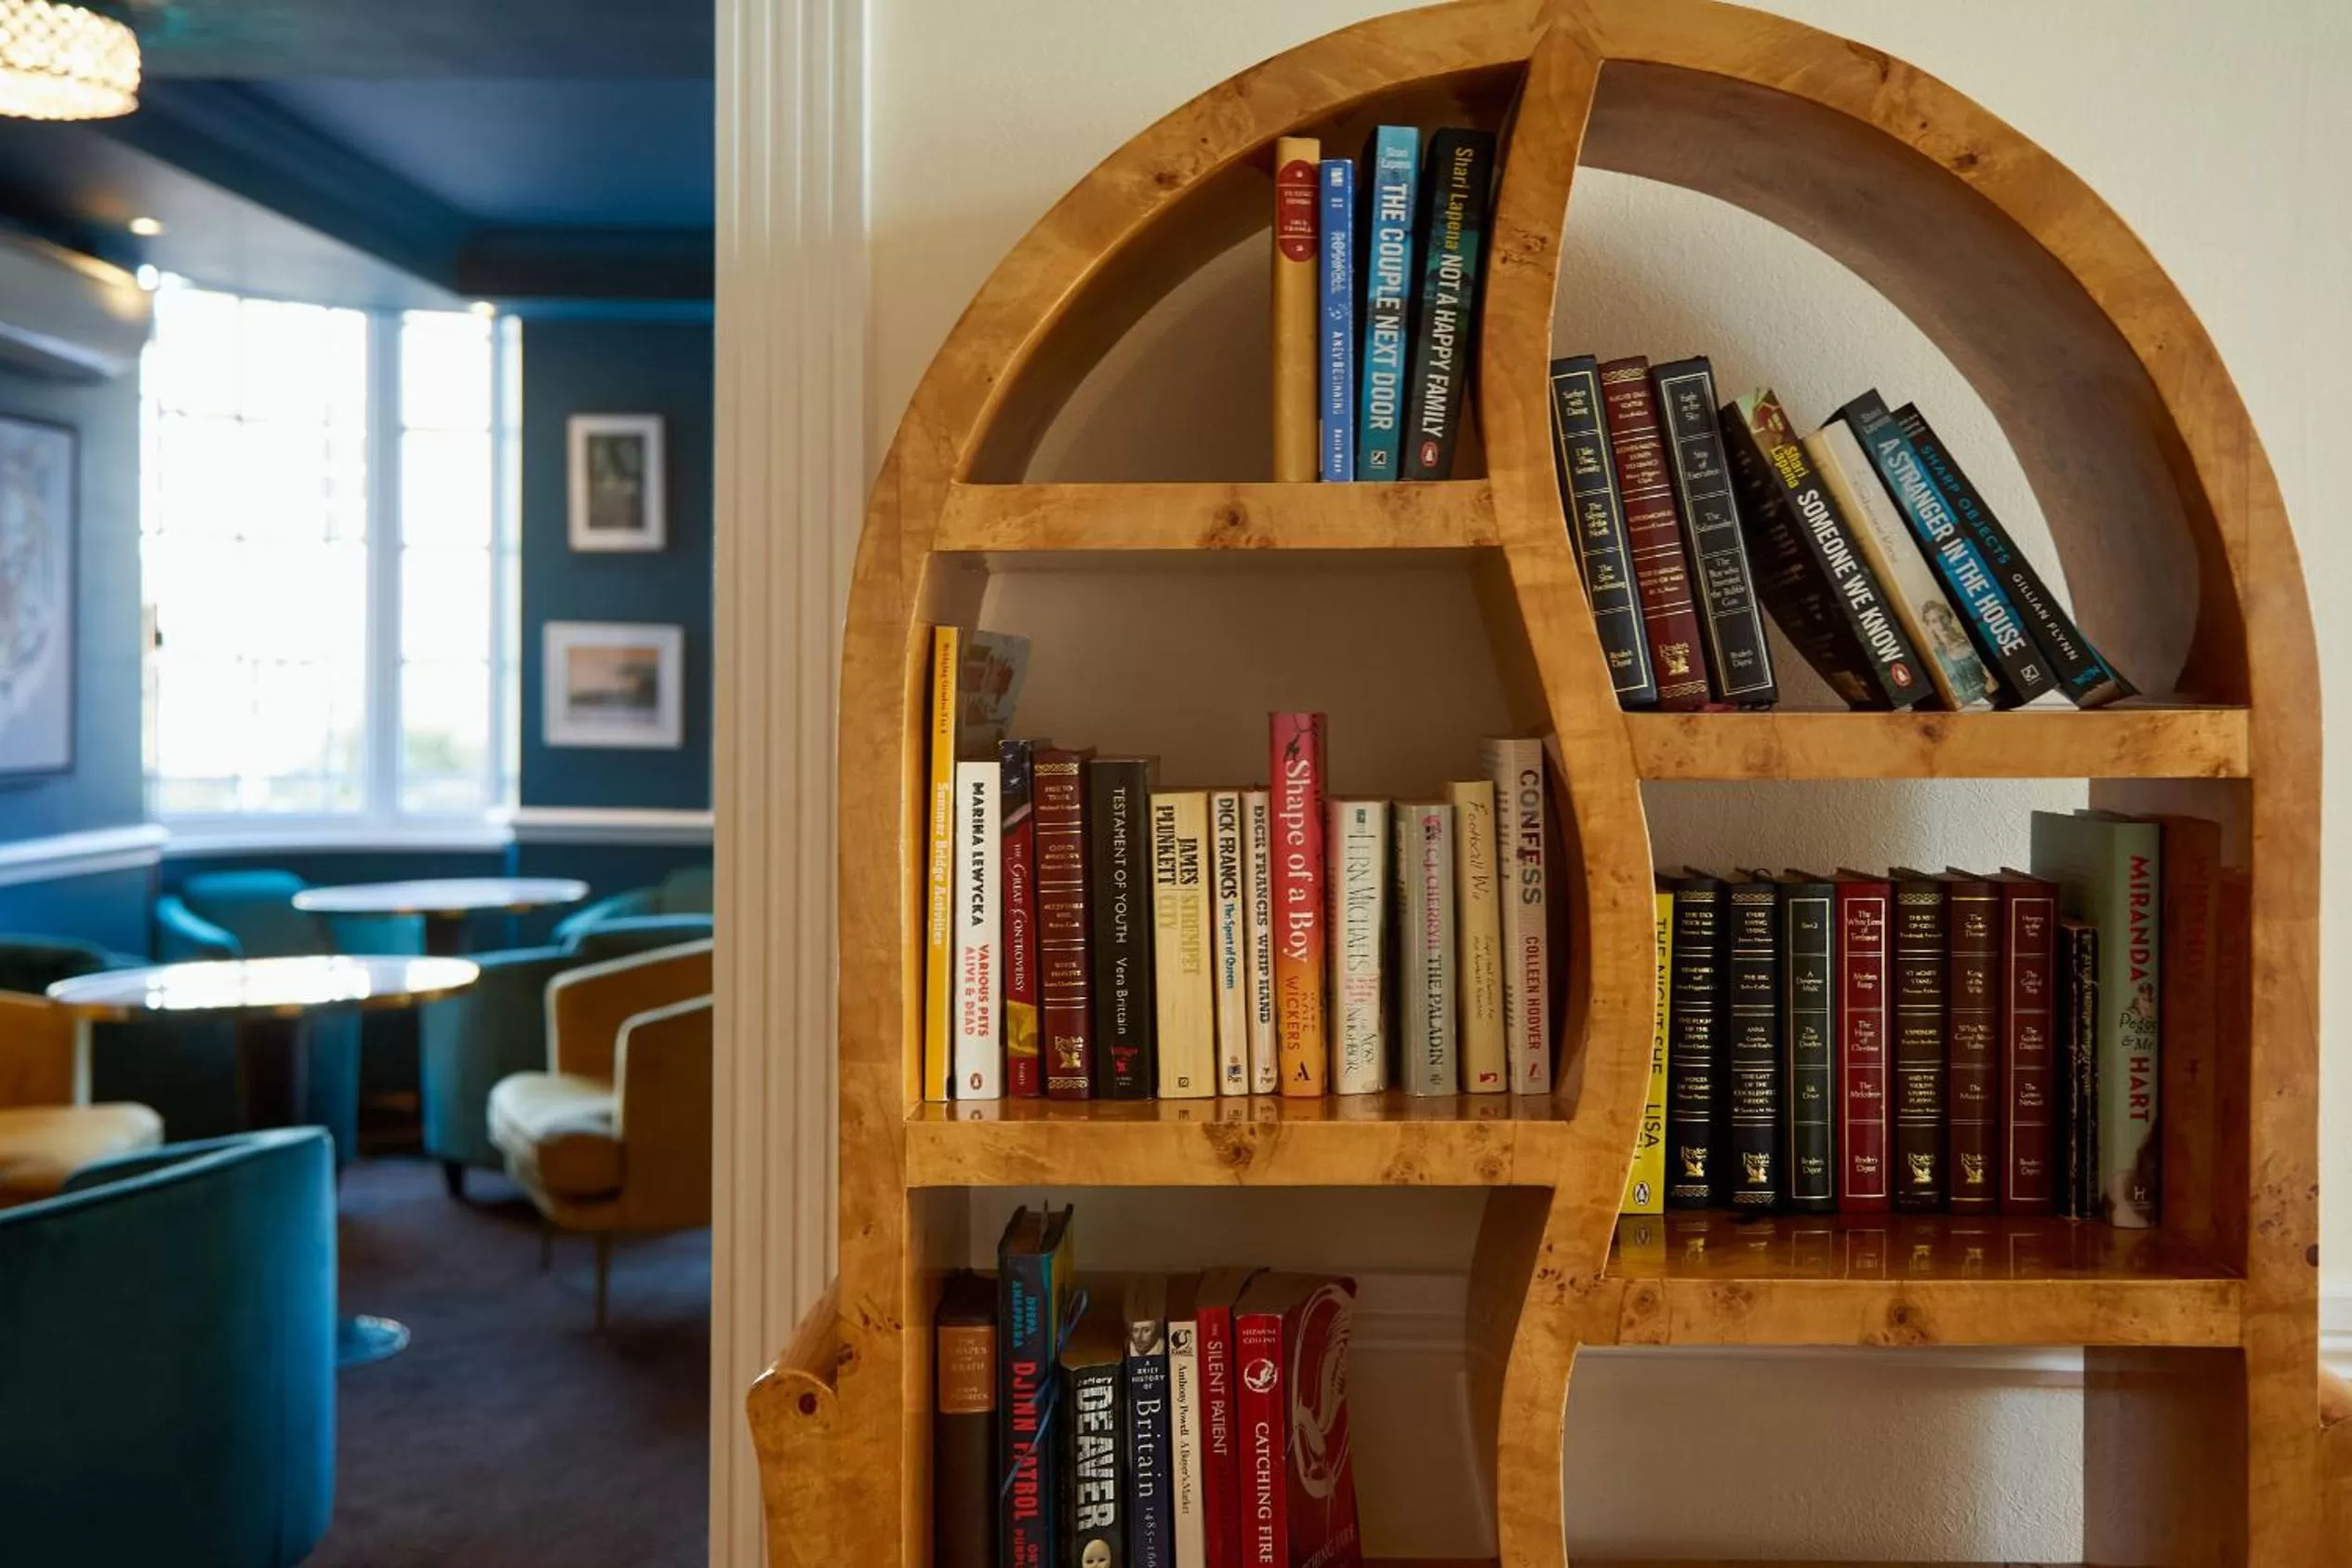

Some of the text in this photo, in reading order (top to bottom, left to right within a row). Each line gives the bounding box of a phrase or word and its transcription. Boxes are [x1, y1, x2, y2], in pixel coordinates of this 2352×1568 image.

[1380, 183, 1408, 221] THE
[1376, 228, 1405, 309] COUPLE
[1421, 147, 1473, 439] Shari Lapena NOT A HAPPY FAMILY
[1372, 315, 1400, 368] NEXT
[1368, 371, 1396, 430] DOOR
[1770, 445, 1800, 489] Lapena
[1785, 445, 1811, 478] Shari
[1878, 438, 1901, 455] A
[1887, 451, 1955, 543] STRANGER
[1921, 445, 2011, 565] SHARP OBJECTS
[1797, 489, 1857, 579] SOMEONE
[1940, 538, 1969, 564] IN
[1842, 574, 1874, 611] WE
[1954, 557, 1990, 598] THE
[1857, 606, 1904, 663] KNOW
[1974, 593, 2027, 658] HOUSE
[2013, 573, 2080, 662] GILLIAN FLYNN
[1156, 805, 1176, 885] PLUNKETT
[1218, 798, 1235, 831] DICK
[1468, 801, 1488, 869] Football
[1519, 769, 1541, 905] CONFESS
[933, 782, 950, 947] Summer Bridge Activities
[972, 782, 984, 927] MARINA LEWYCKA
[1176, 837, 1199, 885] JAMES
[1219, 837, 1238, 899] FRANCIS
[1279, 760, 1313, 963] Shape of a Boy
[1423, 848, 1438, 871] C.J.
[1112, 788, 1129, 1034] TESTAMENT OF YOUTH Vera Brittain
[1159, 895, 1178, 929] CITY
[1180, 895, 1200, 976] STRUMPET
[1225, 904, 1235, 919] The
[1254, 804, 1270, 1024] DICK FRANCIS WHIP HAND
[1348, 886, 1376, 971] MICHAELS
[1655, 918, 1667, 957] THE
[2130, 855, 2149, 982] MIRANDA
[1010, 907, 1027, 991] CONTROVERSY
[1225, 946, 1235, 956] of
[1428, 954, 1442, 990] THE
[964, 947, 976, 1035] ALIVE & DEAD
[977, 944, 990, 1037] VARIOUS PETS
[1285, 976, 1300, 1051] WICKERS
[1525, 937, 1541, 1050] COLLEEN HOOVER
[1428, 992, 1443, 1066] PALADIN
[2130, 1056, 2149, 1123] HART
[1644, 1103, 1661, 1149] LISA
[1012, 1280, 1024, 1349] ANAPPARA
[1025, 1295, 1038, 1335] DEEPA
[1132, 1375, 1166, 1384] HISTORY
[1177, 1364, 1188, 1403] Anthony
[1208, 1341, 1224, 1396] SILENT
[1012, 1360, 1039, 1521] DJINN PATROL
[1136, 1398, 1161, 1497] Britain
[1179, 1405, 1189, 1436] Powell
[1211, 1401, 1227, 1455] PATIENT
[1076, 1384, 1115, 1532] DEAVER
[1255, 1422, 1273, 1563] CATCHING FIRE
